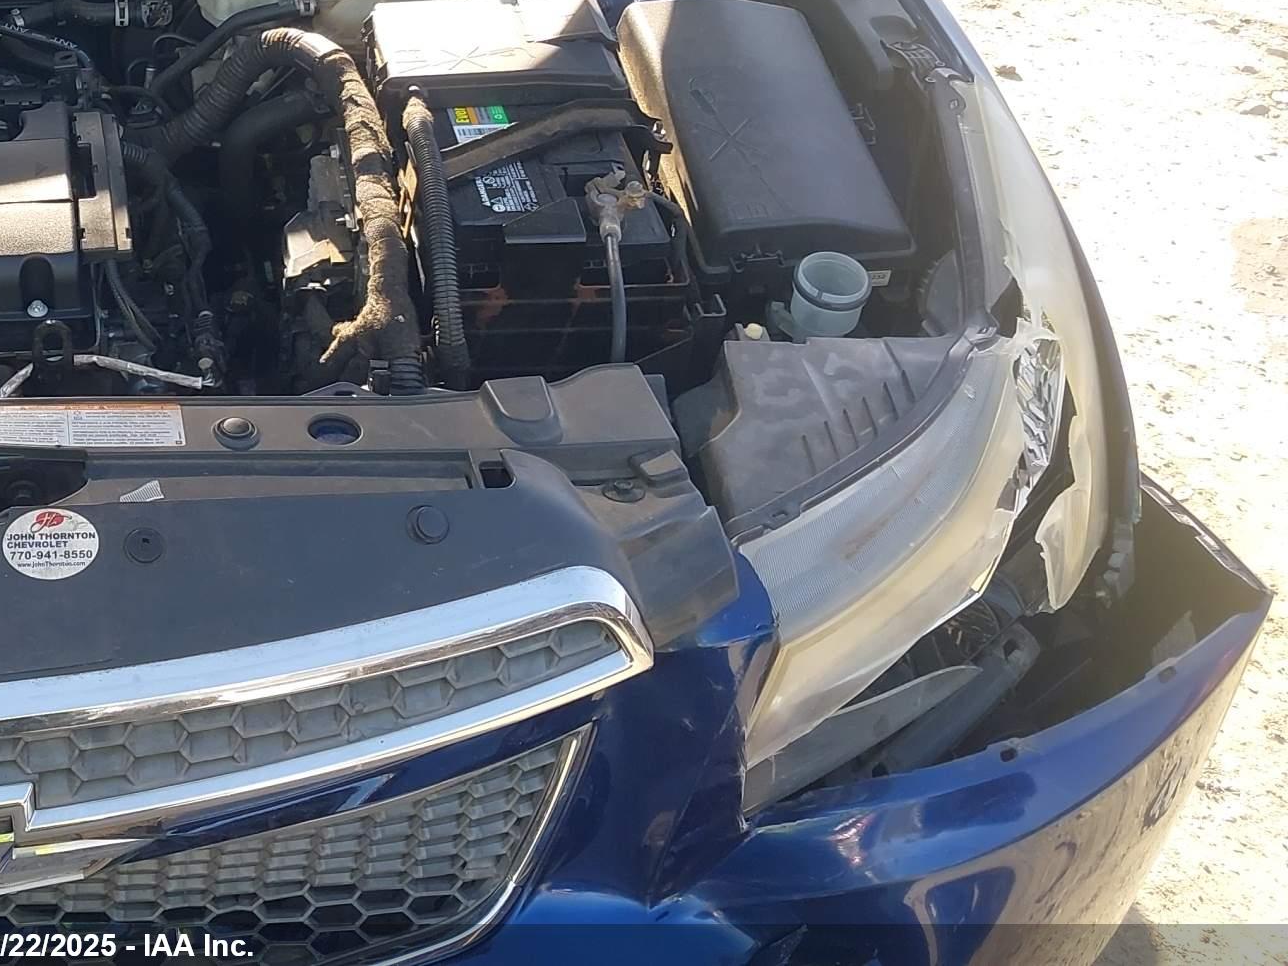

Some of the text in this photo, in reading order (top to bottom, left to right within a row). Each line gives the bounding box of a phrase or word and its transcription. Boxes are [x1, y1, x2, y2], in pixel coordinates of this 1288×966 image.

[39, 532, 96, 540] THORNTON
[7, 540, 69, 549] CHEVROLET
[10, 550, 93, 560] 770-941-8550
